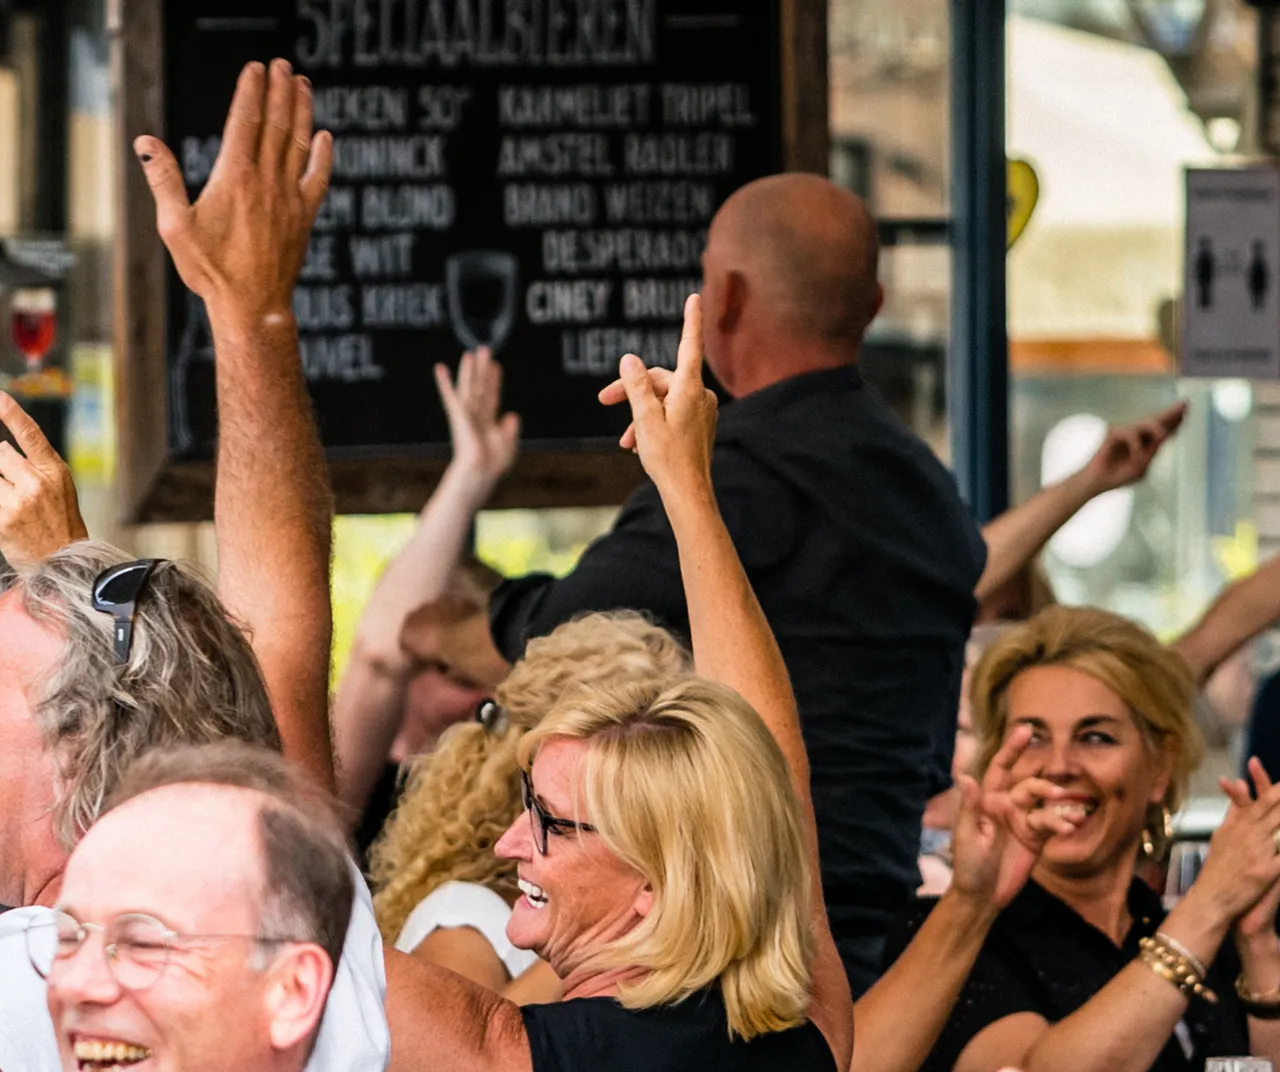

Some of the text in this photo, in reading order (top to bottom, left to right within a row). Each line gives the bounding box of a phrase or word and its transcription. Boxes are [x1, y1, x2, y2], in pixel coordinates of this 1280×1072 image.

[661, 82, 758, 127] TRIPEL
[498, 132, 616, 176] AMSTEL
[362, 183, 456, 229] BLOND
[504, 181, 597, 227] BRAND
[348, 232, 415, 277] WIT
[526, 279, 613, 325] CINEY
